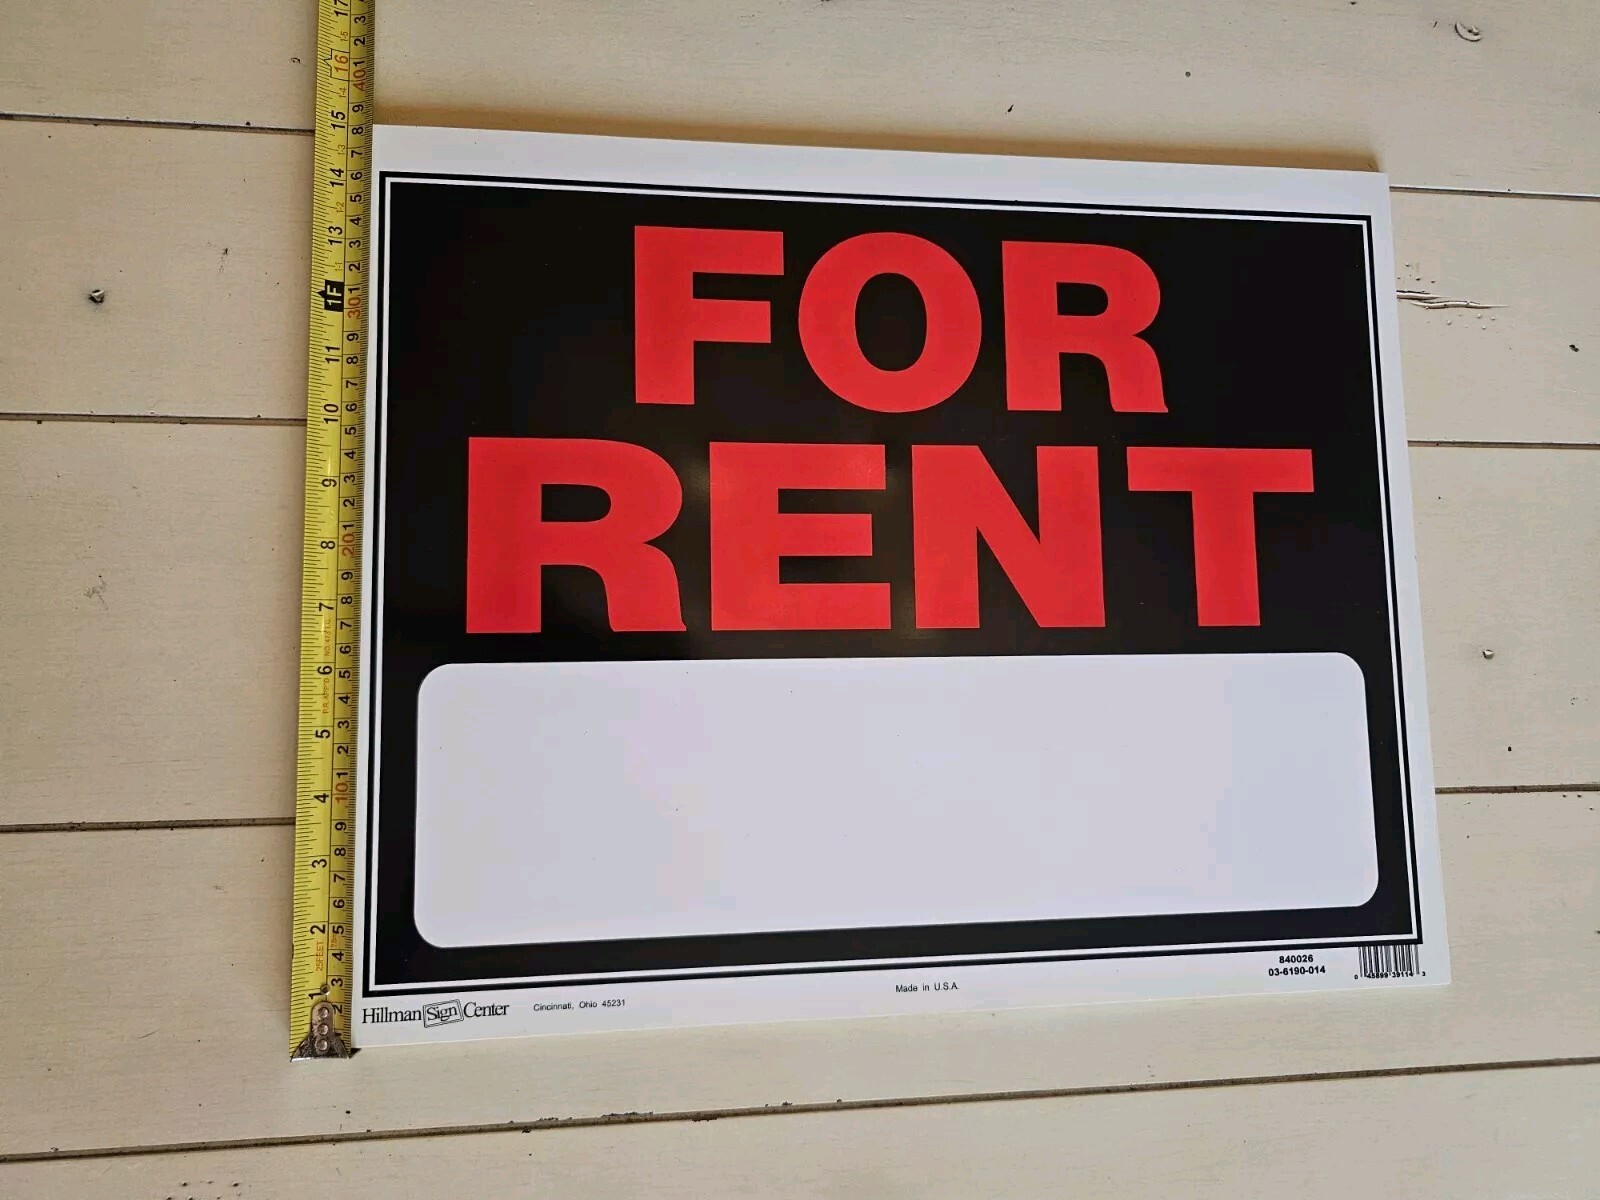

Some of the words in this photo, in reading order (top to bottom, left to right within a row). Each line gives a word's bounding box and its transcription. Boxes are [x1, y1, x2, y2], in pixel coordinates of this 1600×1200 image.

[354, 15, 366, 24] 3
[353, 37, 366, 46] 2
[334, 55, 349, 73] 16
[352, 69, 366, 92] 40
[352, 104, 364, 113] 9
[331, 110, 346, 130] 15
[351, 126, 364, 135] 8
[351, 150, 363, 158] 7
[329, 168, 344, 188] 14
[350, 172, 363, 181] 6
[350, 194, 362, 203] 5
[350, 217, 362, 226] 4
[328, 226, 343, 246] 13
[349, 239, 361, 248] 3
[348, 262, 361, 272] 2
[348, 286, 360, 294] 1
[327, 285, 342, 306] 1F
[348, 297, 361, 319] 30
[634, 226, 1169, 413] FOR
[347, 333, 359, 342] 9
[325, 346, 340, 364] 11
[347, 356, 359, 365] 8
[346, 379, 358, 388] 7
[346, 403, 358, 412] 6
[323, 404, 339, 424] 10
[345, 427, 357, 436] 5
[344, 451, 356, 460] 4
[322, 478, 337, 487] 9
[344, 475, 356, 483] 3
[343, 498, 355, 508] 2
[343, 523, 354, 531] 1
[466, 437, 1314, 634] RENT
[320, 540, 335, 550] 8
[342, 533, 355, 557] 20
[342, 571, 353, 581] 9
[341, 596, 352, 605] 8
[319, 602, 334, 612] 7
[340, 621, 352, 630] 7
[340, 645, 351, 655] 6
[317, 666, 332, 675] 6
[339, 670, 351, 679] 5
[338, 695, 350, 704] 4
[338, 720, 350, 730] 3
[315, 729, 331, 739] 5
[337, 745, 349, 755] 2
[336, 771, 348, 779] 1
[335, 782, 349, 803] 10
[314, 793, 329, 804] 4
[335, 821, 347, 831] 9
[334, 847, 347, 857] 8
[312, 858, 327, 869] 3
[333, 873, 346, 883] 7
[332, 899, 345, 909] 6
[310, 925, 325, 935] 2
[331, 925, 344, 935] 5
[332, 951, 344, 961] 4
[1279, 954, 1314, 964] 840026
[1268, 965, 1326, 976] 03-6190-014
[331, 978, 343, 987] 3
[895, 984, 918, 992] Made
[922, 983, 930, 991] in
[308, 992, 322, 1000] 1
[533, 1002, 575, 1011] Cincinnati,
[579, 1000, 598, 1008] Ohio
[602, 999, 625, 1007] 45231
[362, 1007, 422, 1024] Hillman
[426, 1003, 458, 1022] Sign
[463, 1001, 510, 1018] Center
